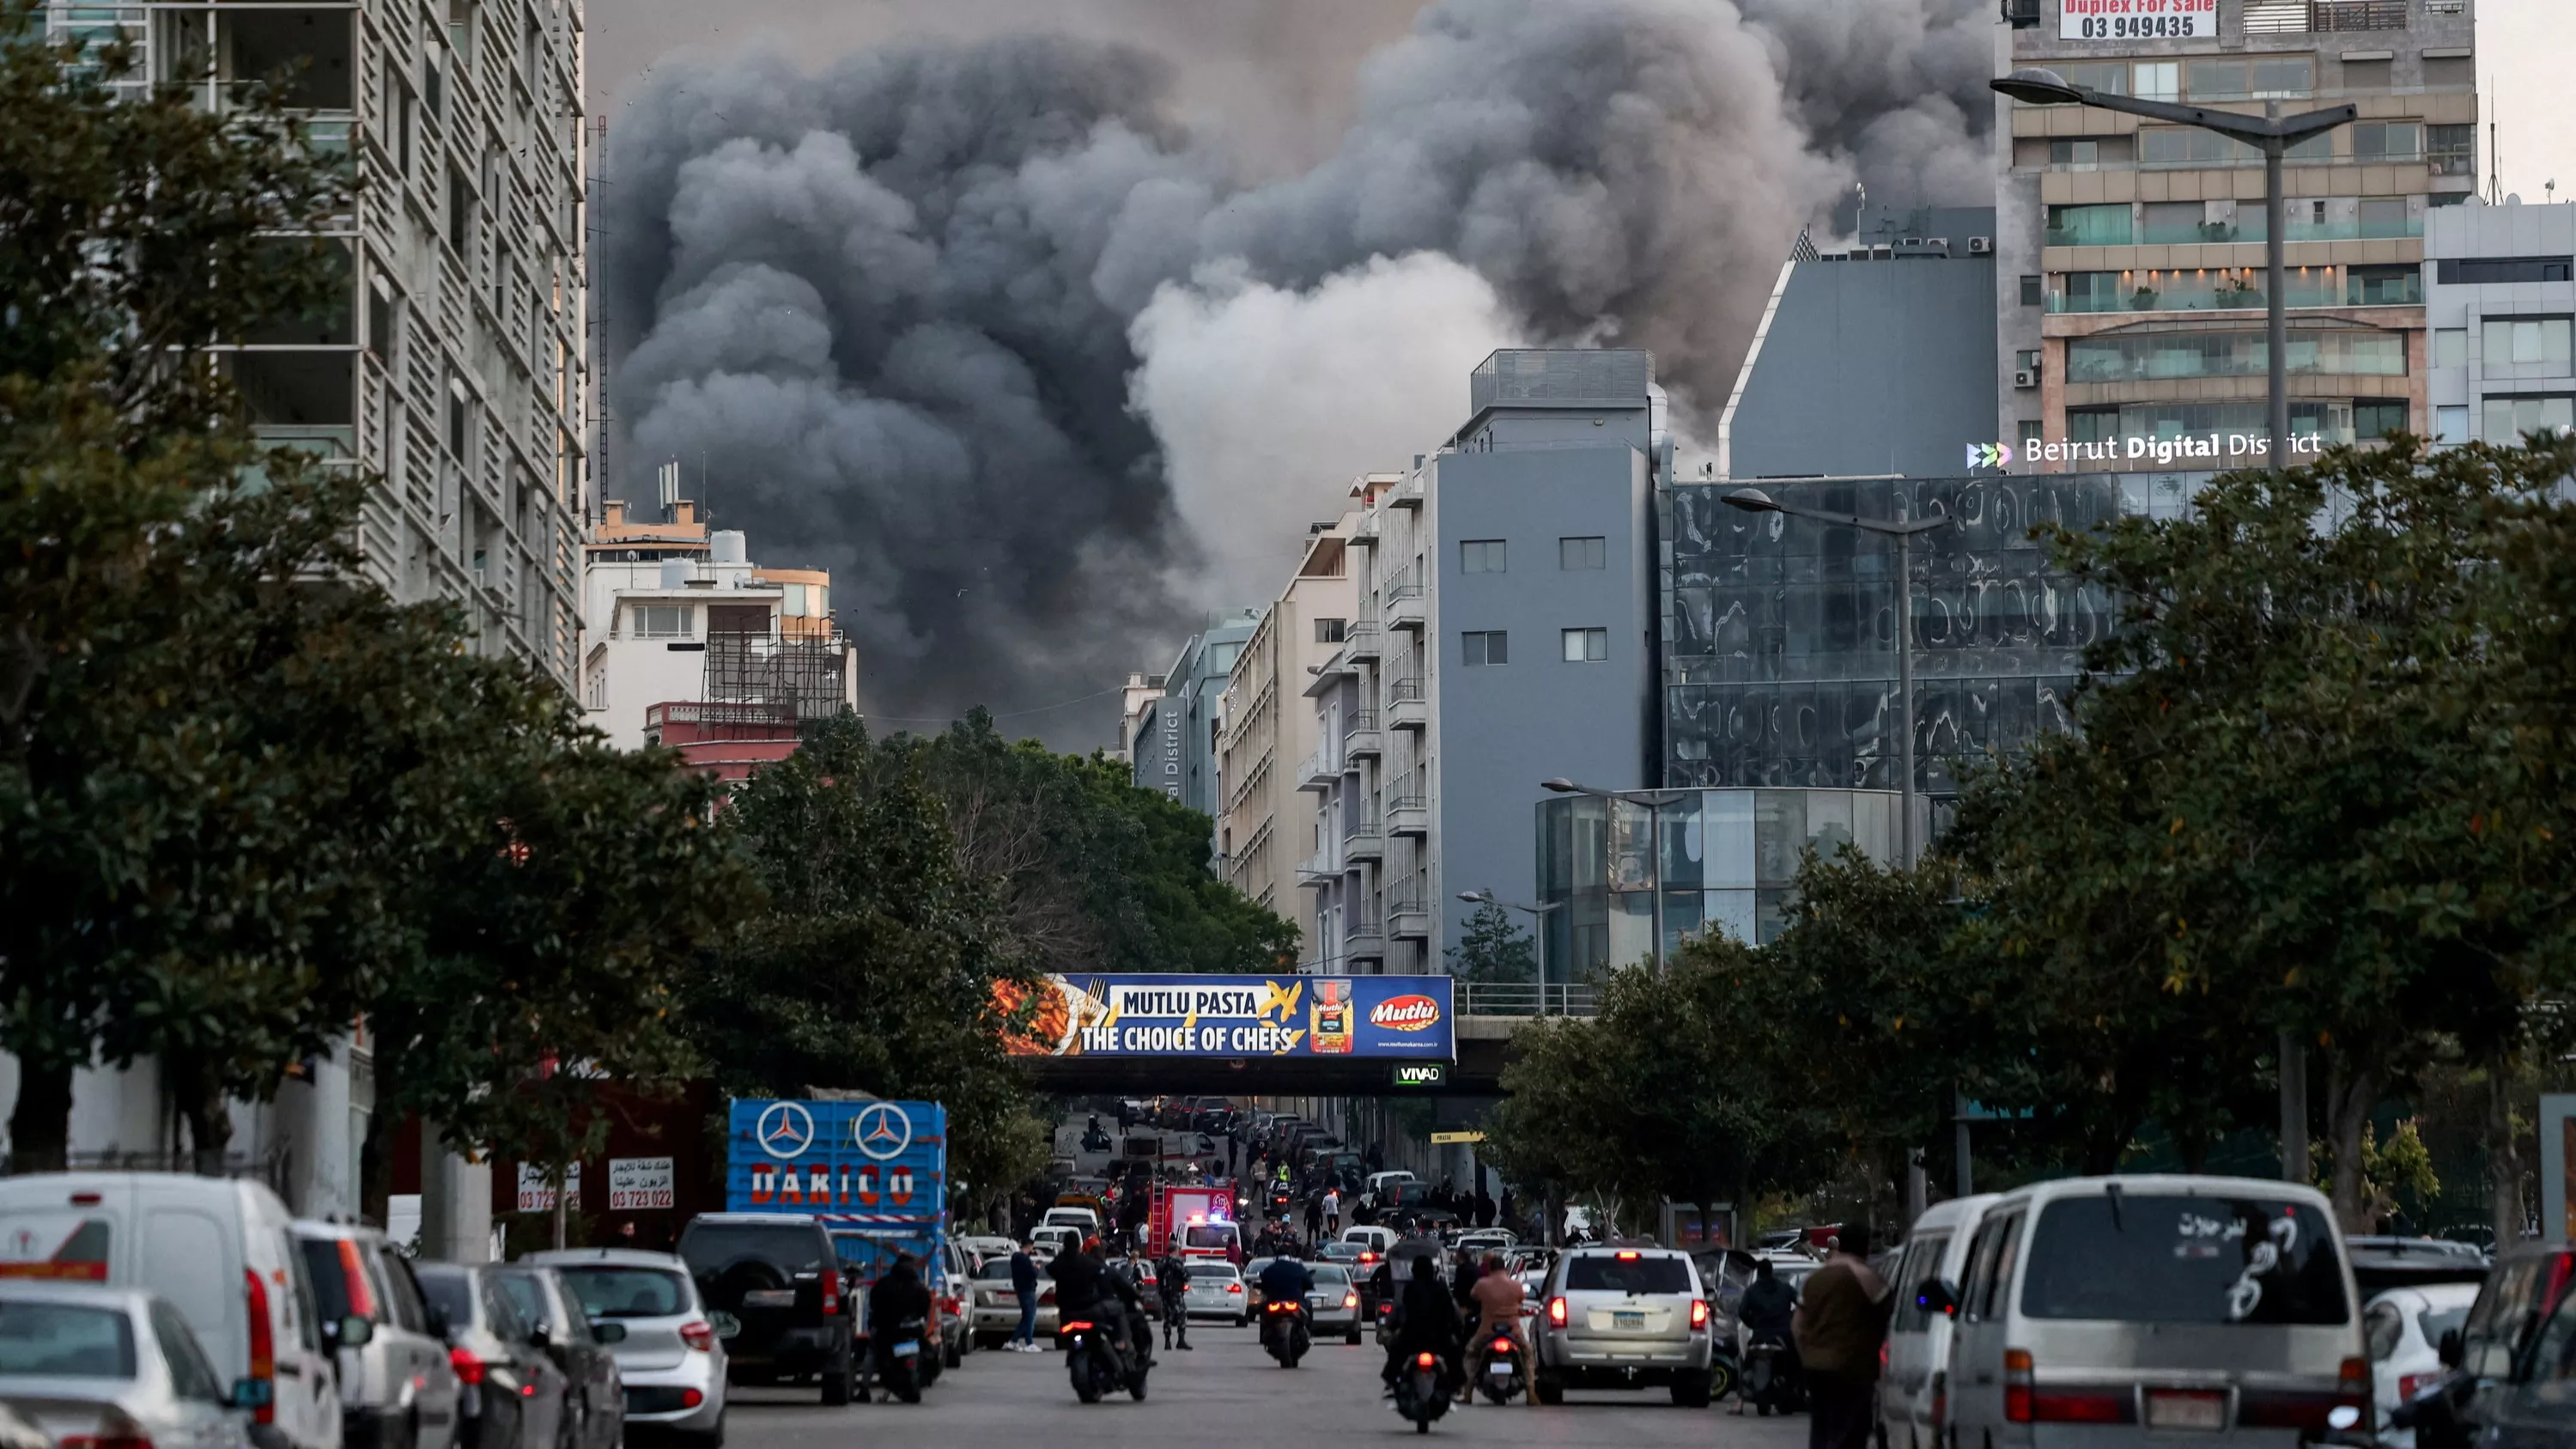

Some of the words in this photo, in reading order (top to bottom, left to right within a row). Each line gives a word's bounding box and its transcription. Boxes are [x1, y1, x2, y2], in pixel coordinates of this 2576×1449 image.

[2065, 0, 2130, 16] Duplex
[2137, 0, 2166, 12] For
[2172, 0, 2214, 11] Sale
[2081, 17, 2107, 38] 03
[2114, 16, 2193, 37] 949435
[2026, 436, 2118, 462] Beirut
[2127, 433, 2221, 464] Digital
[2229, 431, 2322, 456] Disict
[1164, 711, 1178, 775] District
[1123, 992, 1190, 1014] MUTLU
[1196, 992, 1257, 1014] PASTA
[1370, 1001, 1436, 1023] Mutlu
[1081, 1027, 1119, 1051] THE
[1124, 1026, 1196, 1050] CHOICE
[1201, 1026, 1227, 1050] OF
[1231, 1027, 1291, 1050] CHEFS
[751, 1162, 914, 1207] DARICO
[520, 1191, 533, 1208] 03
[612, 1191, 626, 1207] 03
[629, 1190, 649, 1206] 723
[652, 1190, 672, 1206] 022
